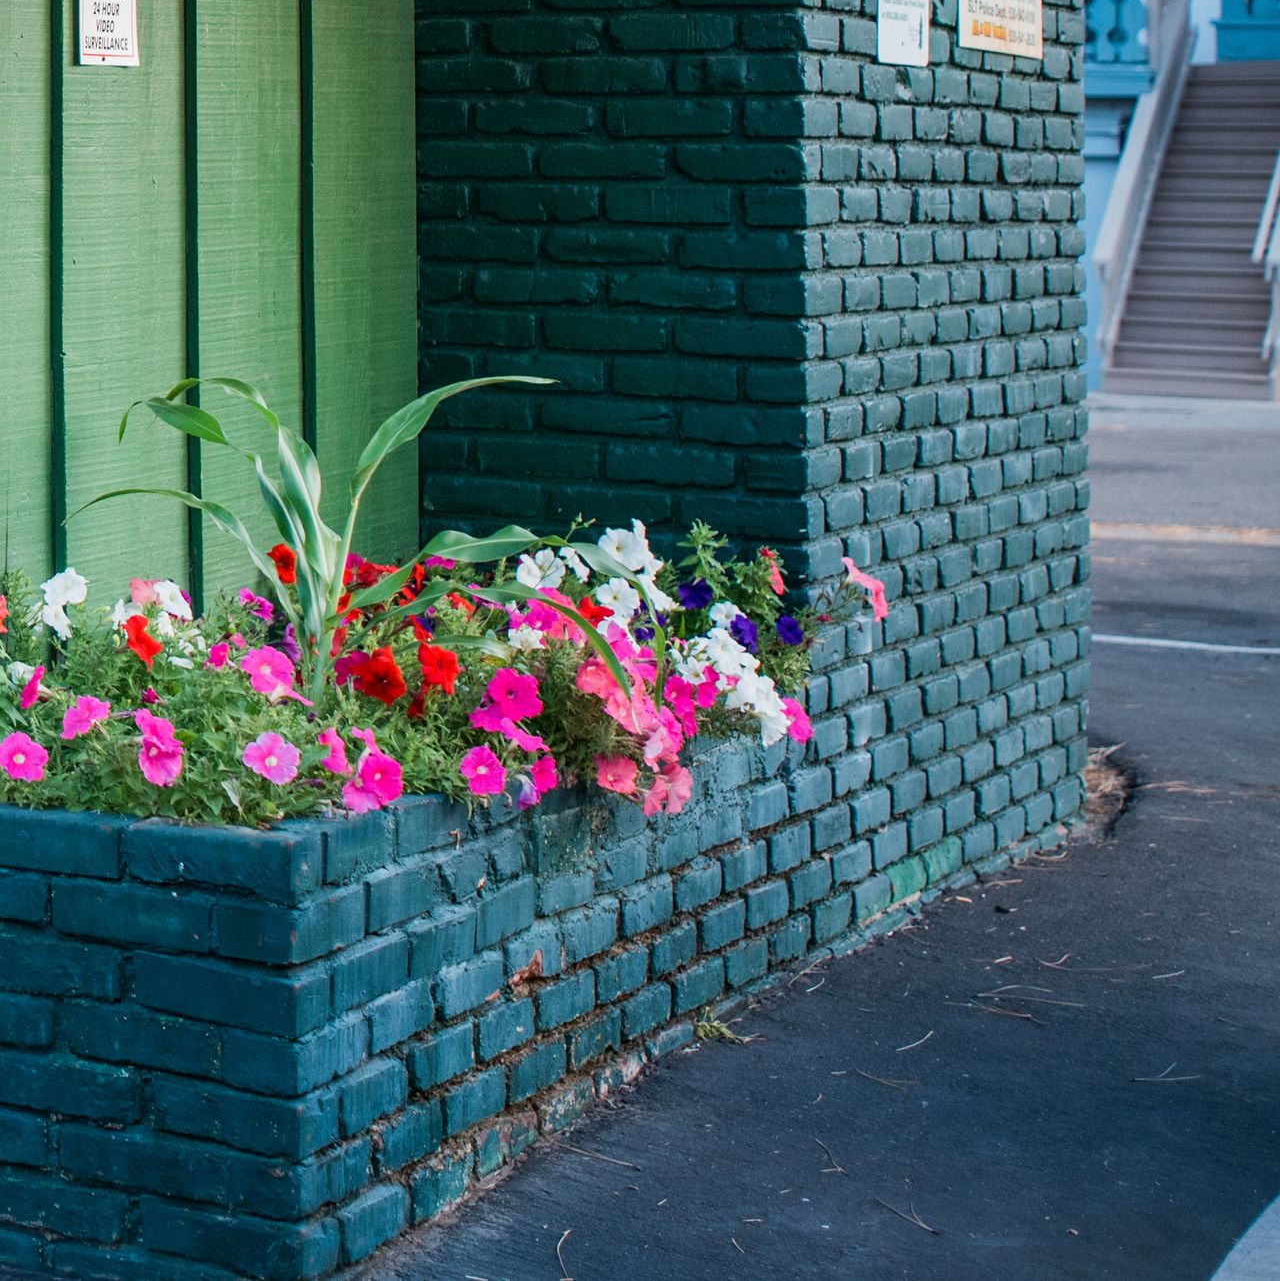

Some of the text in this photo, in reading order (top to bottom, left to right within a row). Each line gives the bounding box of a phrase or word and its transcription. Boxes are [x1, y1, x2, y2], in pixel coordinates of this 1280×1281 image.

[93, 2, 120, 17] 24 HOUR
[95, 19, 115, 33] VIDEO
[85, 35, 129, 51] SURVEILLANCE
